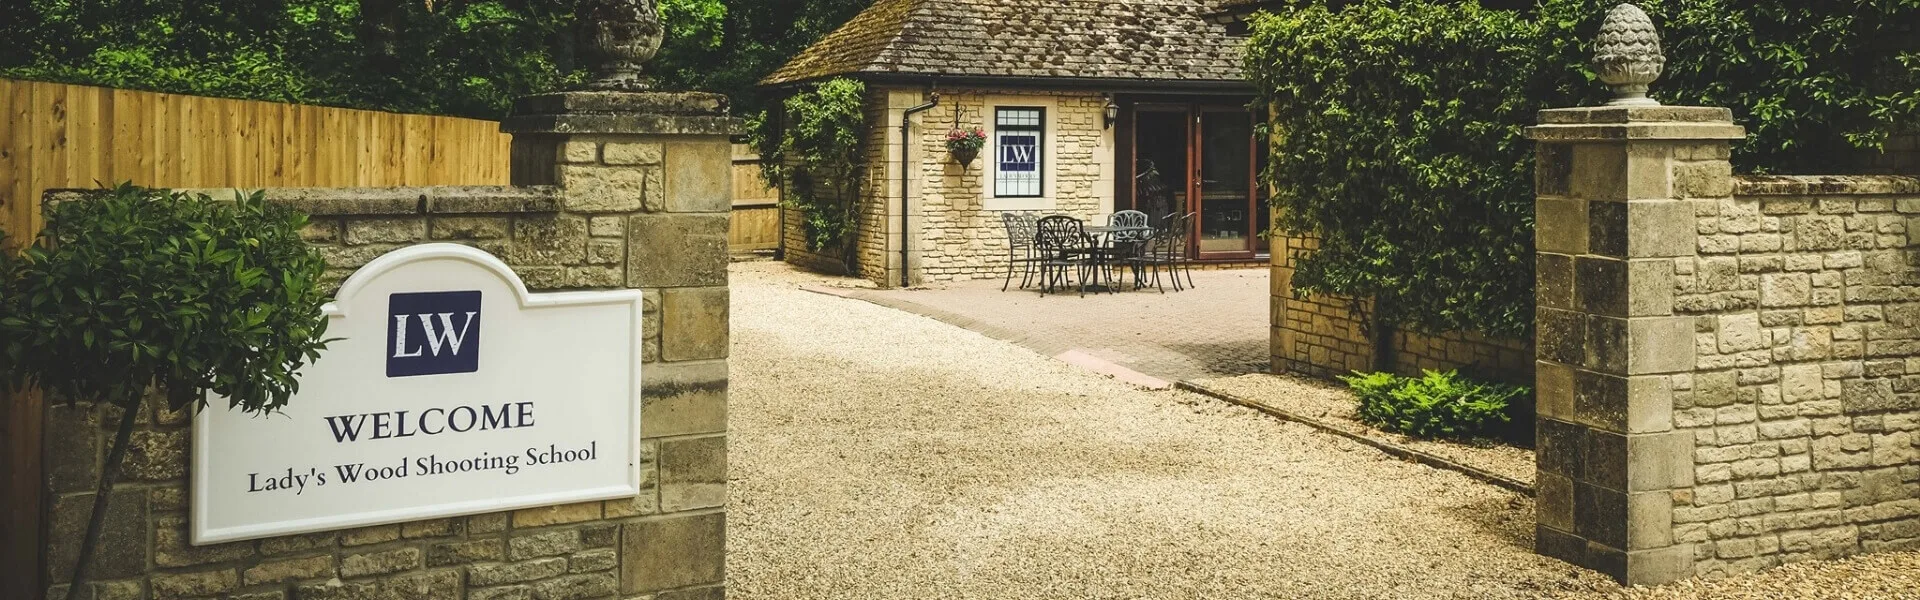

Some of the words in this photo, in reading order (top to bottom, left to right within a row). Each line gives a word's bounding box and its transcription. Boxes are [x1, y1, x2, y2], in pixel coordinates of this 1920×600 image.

[1002, 145, 1034, 163] LW
[393, 311, 477, 358] LW
[325, 402, 535, 443] WELCOME
[248, 468, 326, 495] Lady's
[335, 458, 408, 484] Wood
[416, 451, 519, 476] Shooting
[525, 441, 597, 468] School
